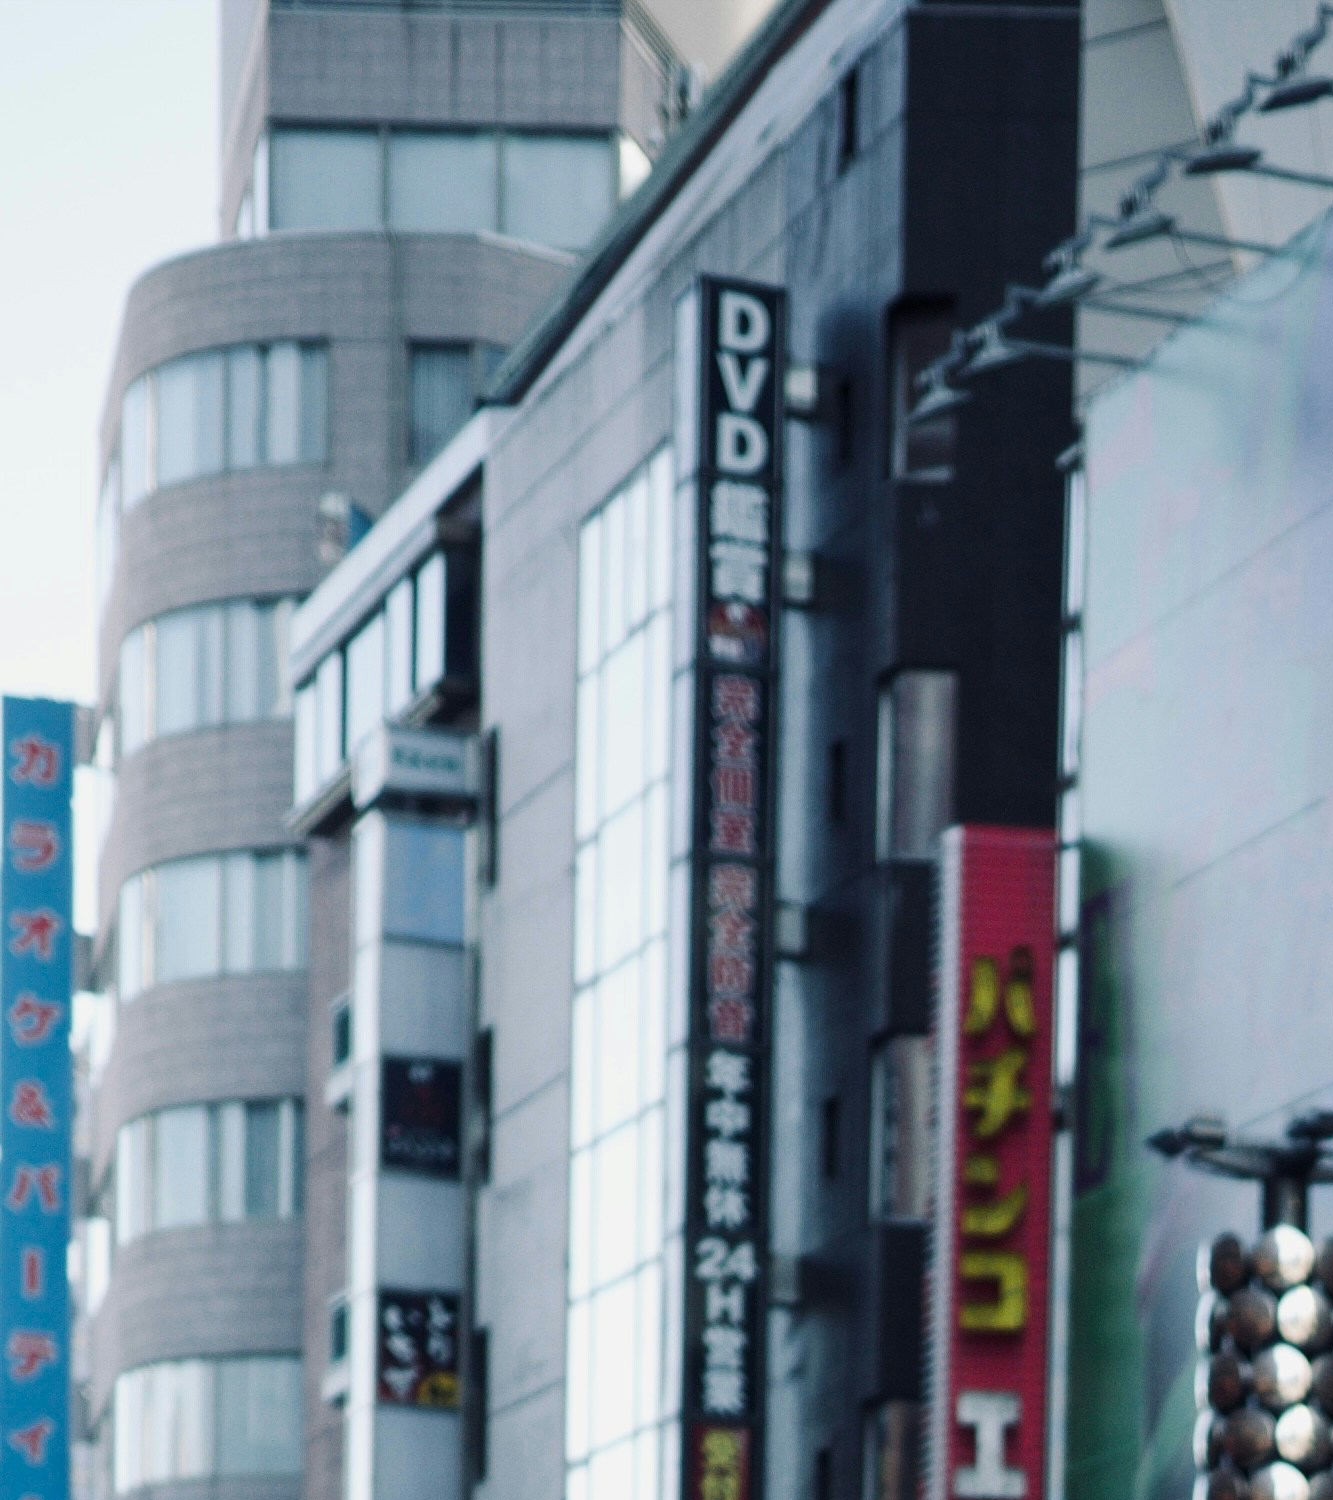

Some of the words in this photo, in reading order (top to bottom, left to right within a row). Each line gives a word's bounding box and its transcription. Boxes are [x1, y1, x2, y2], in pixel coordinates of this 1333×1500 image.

[711, 290, 772, 604] DVD鑑賞
[960, 945, 1036, 1333] パチンコ
